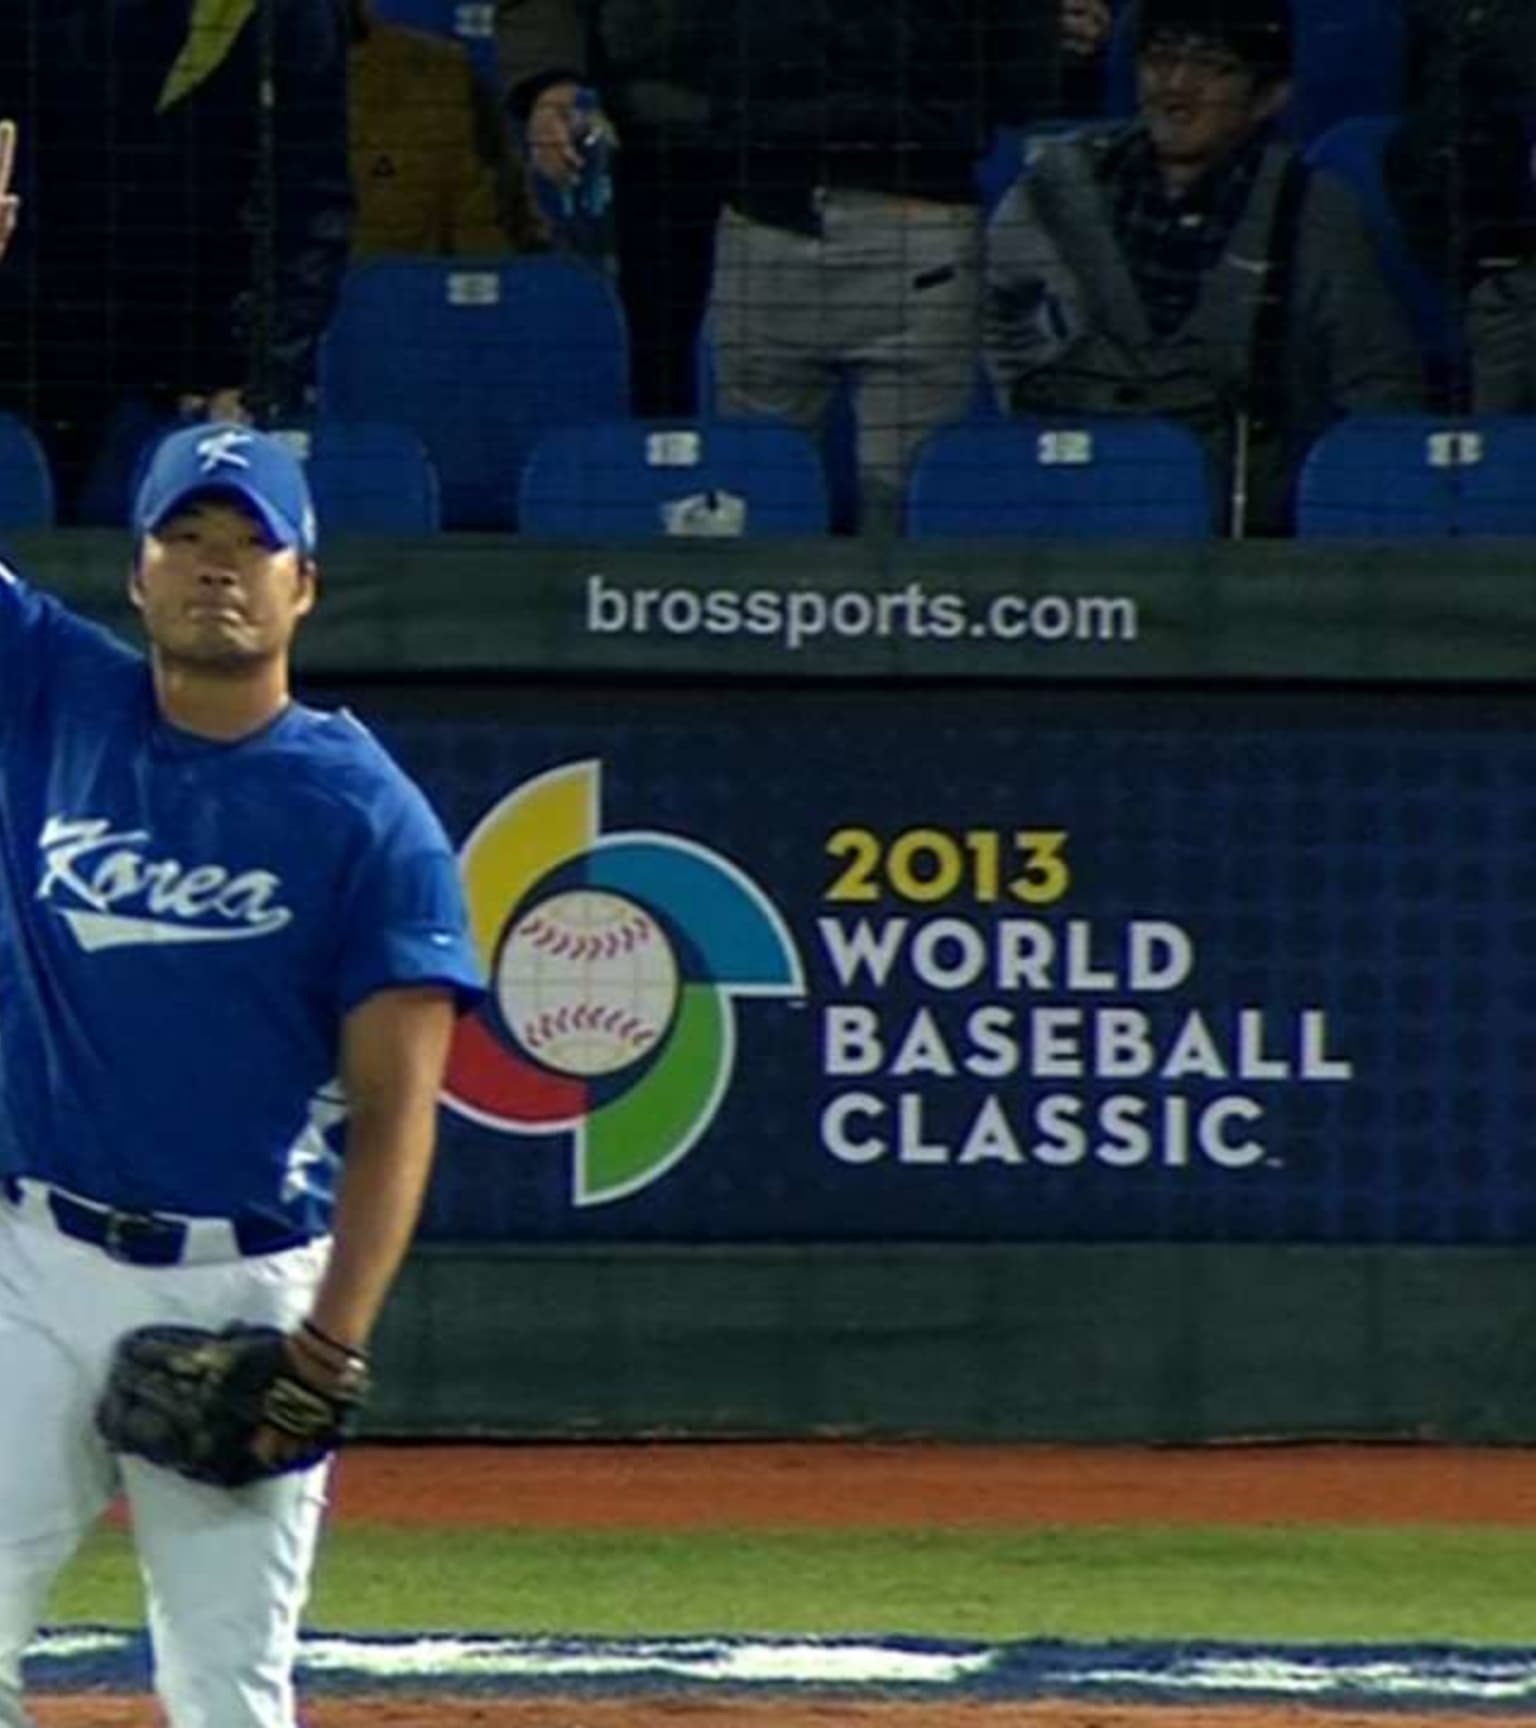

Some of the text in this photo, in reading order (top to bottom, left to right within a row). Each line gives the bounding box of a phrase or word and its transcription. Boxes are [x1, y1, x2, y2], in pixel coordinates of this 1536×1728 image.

[587, 575, 1138, 648] brossports.com
[37, 817, 292, 920] Korea
[824, 829, 1069, 903] 2013
[817, 917, 1193, 991] WORLD
[824, 1006, 1352, 1079] BASEBALL
[821, 1093, 1265, 1167] CLASSIC
